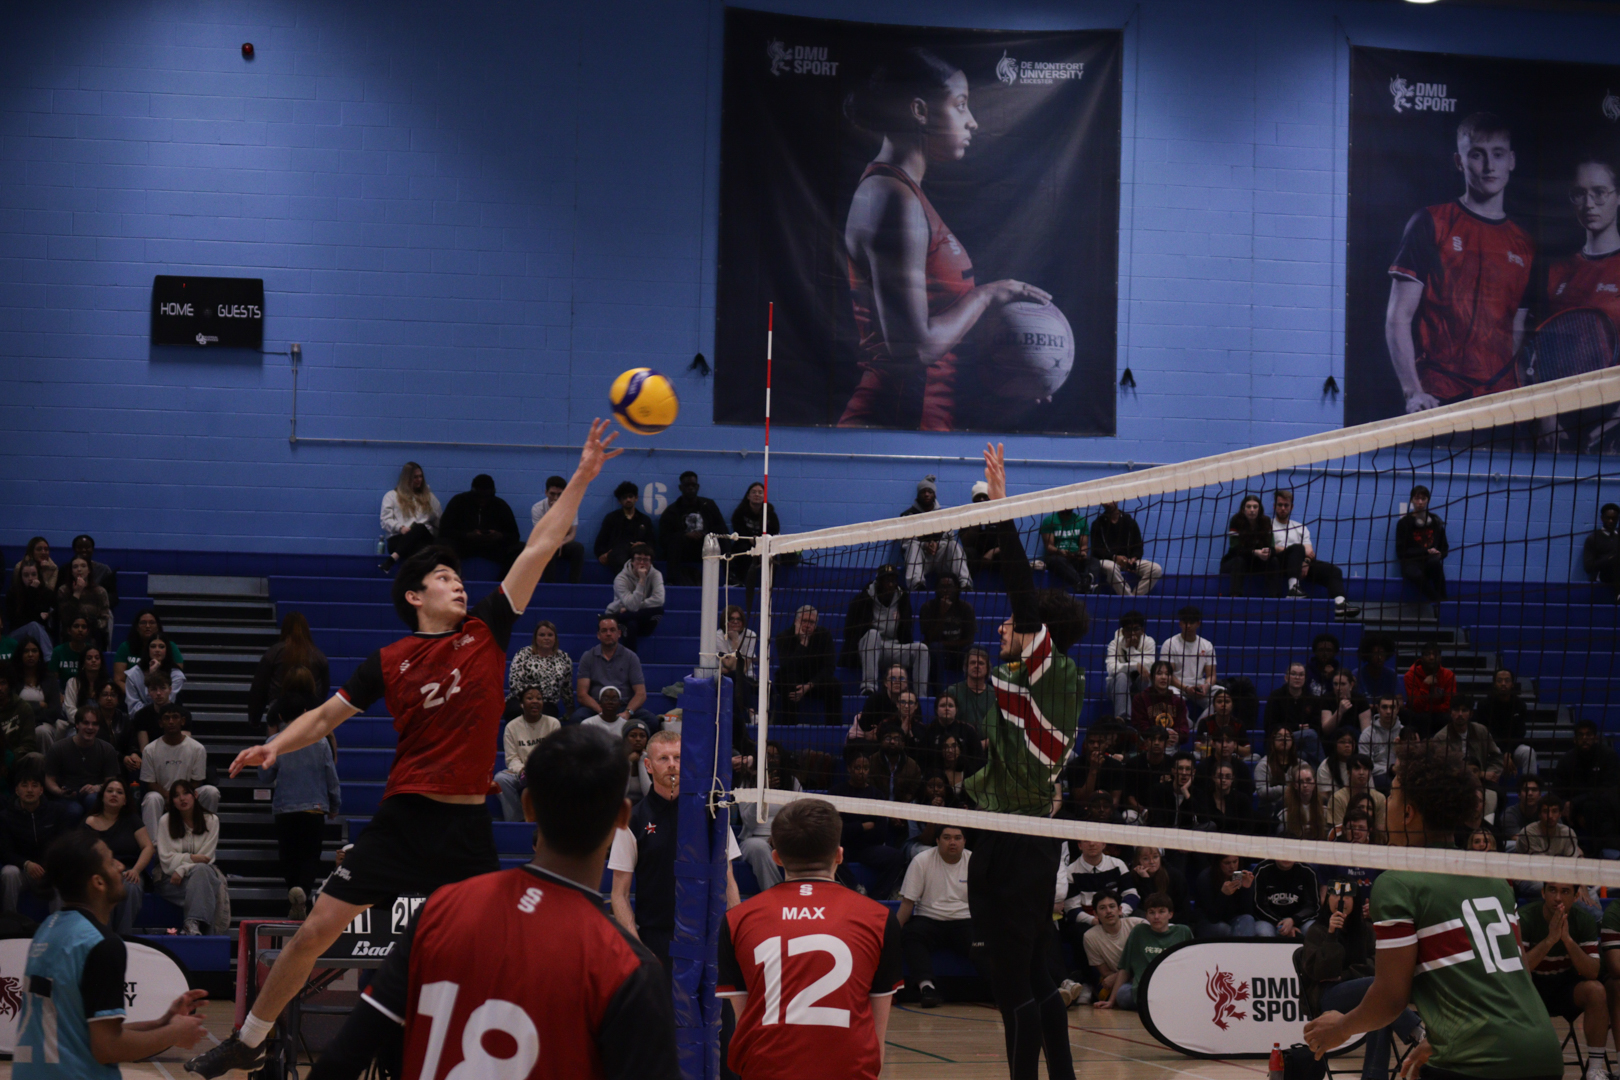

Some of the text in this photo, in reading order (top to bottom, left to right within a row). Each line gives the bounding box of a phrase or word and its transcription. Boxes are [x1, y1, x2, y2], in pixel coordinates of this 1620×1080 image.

[794, 45, 828, 61] DMU
[793, 60, 839, 76] SPORT
[1020, 61, 1085, 70] DE MONTFORT
[1020, 69, 1084, 80] UNIVERSITY
[1415, 82, 1447, 98] DMU
[1414, 97, 1458, 112] SPORT
[160, 302, 262, 319] HOME GUESTS
[642, 481, 668, 516] 6
[420, 667, 462, 710] 22
[781, 906, 826, 921] MAX
[1461, 896, 1524, 974] 12
[351, 940, 397, 956] Bad
[753, 933, 853, 1028] 12
[417, 979, 541, 1080] 18
